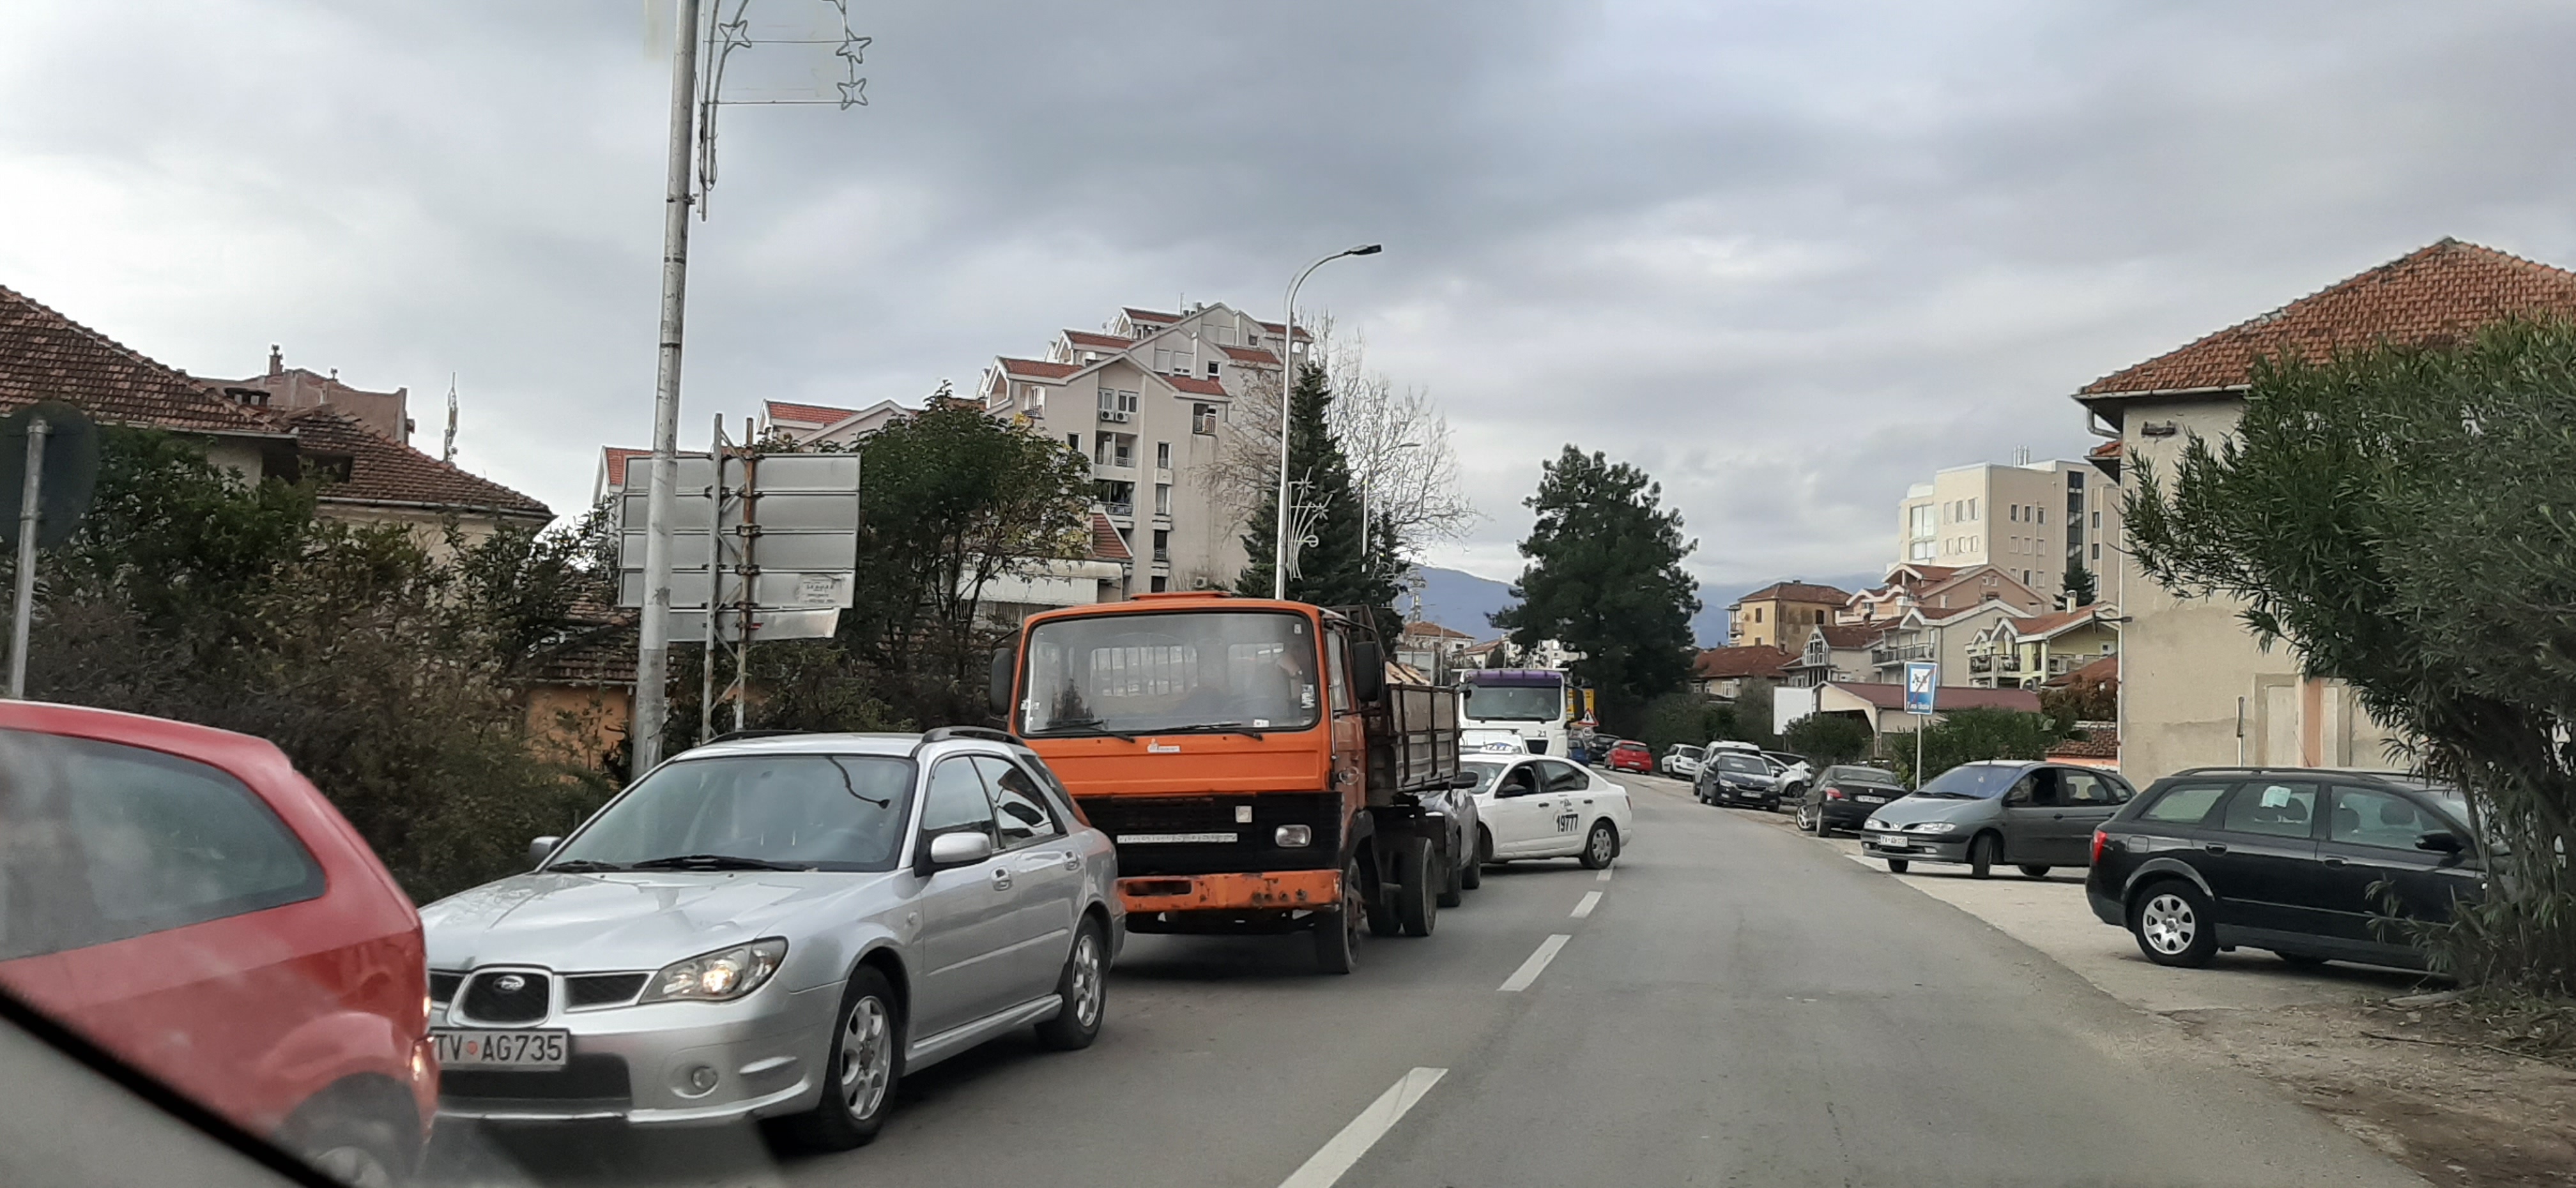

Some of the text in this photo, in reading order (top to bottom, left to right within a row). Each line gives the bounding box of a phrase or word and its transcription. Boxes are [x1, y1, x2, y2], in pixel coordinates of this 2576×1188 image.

[1556, 814, 1578, 832] 19777
[435, 1034, 563, 1062] TV AG735
